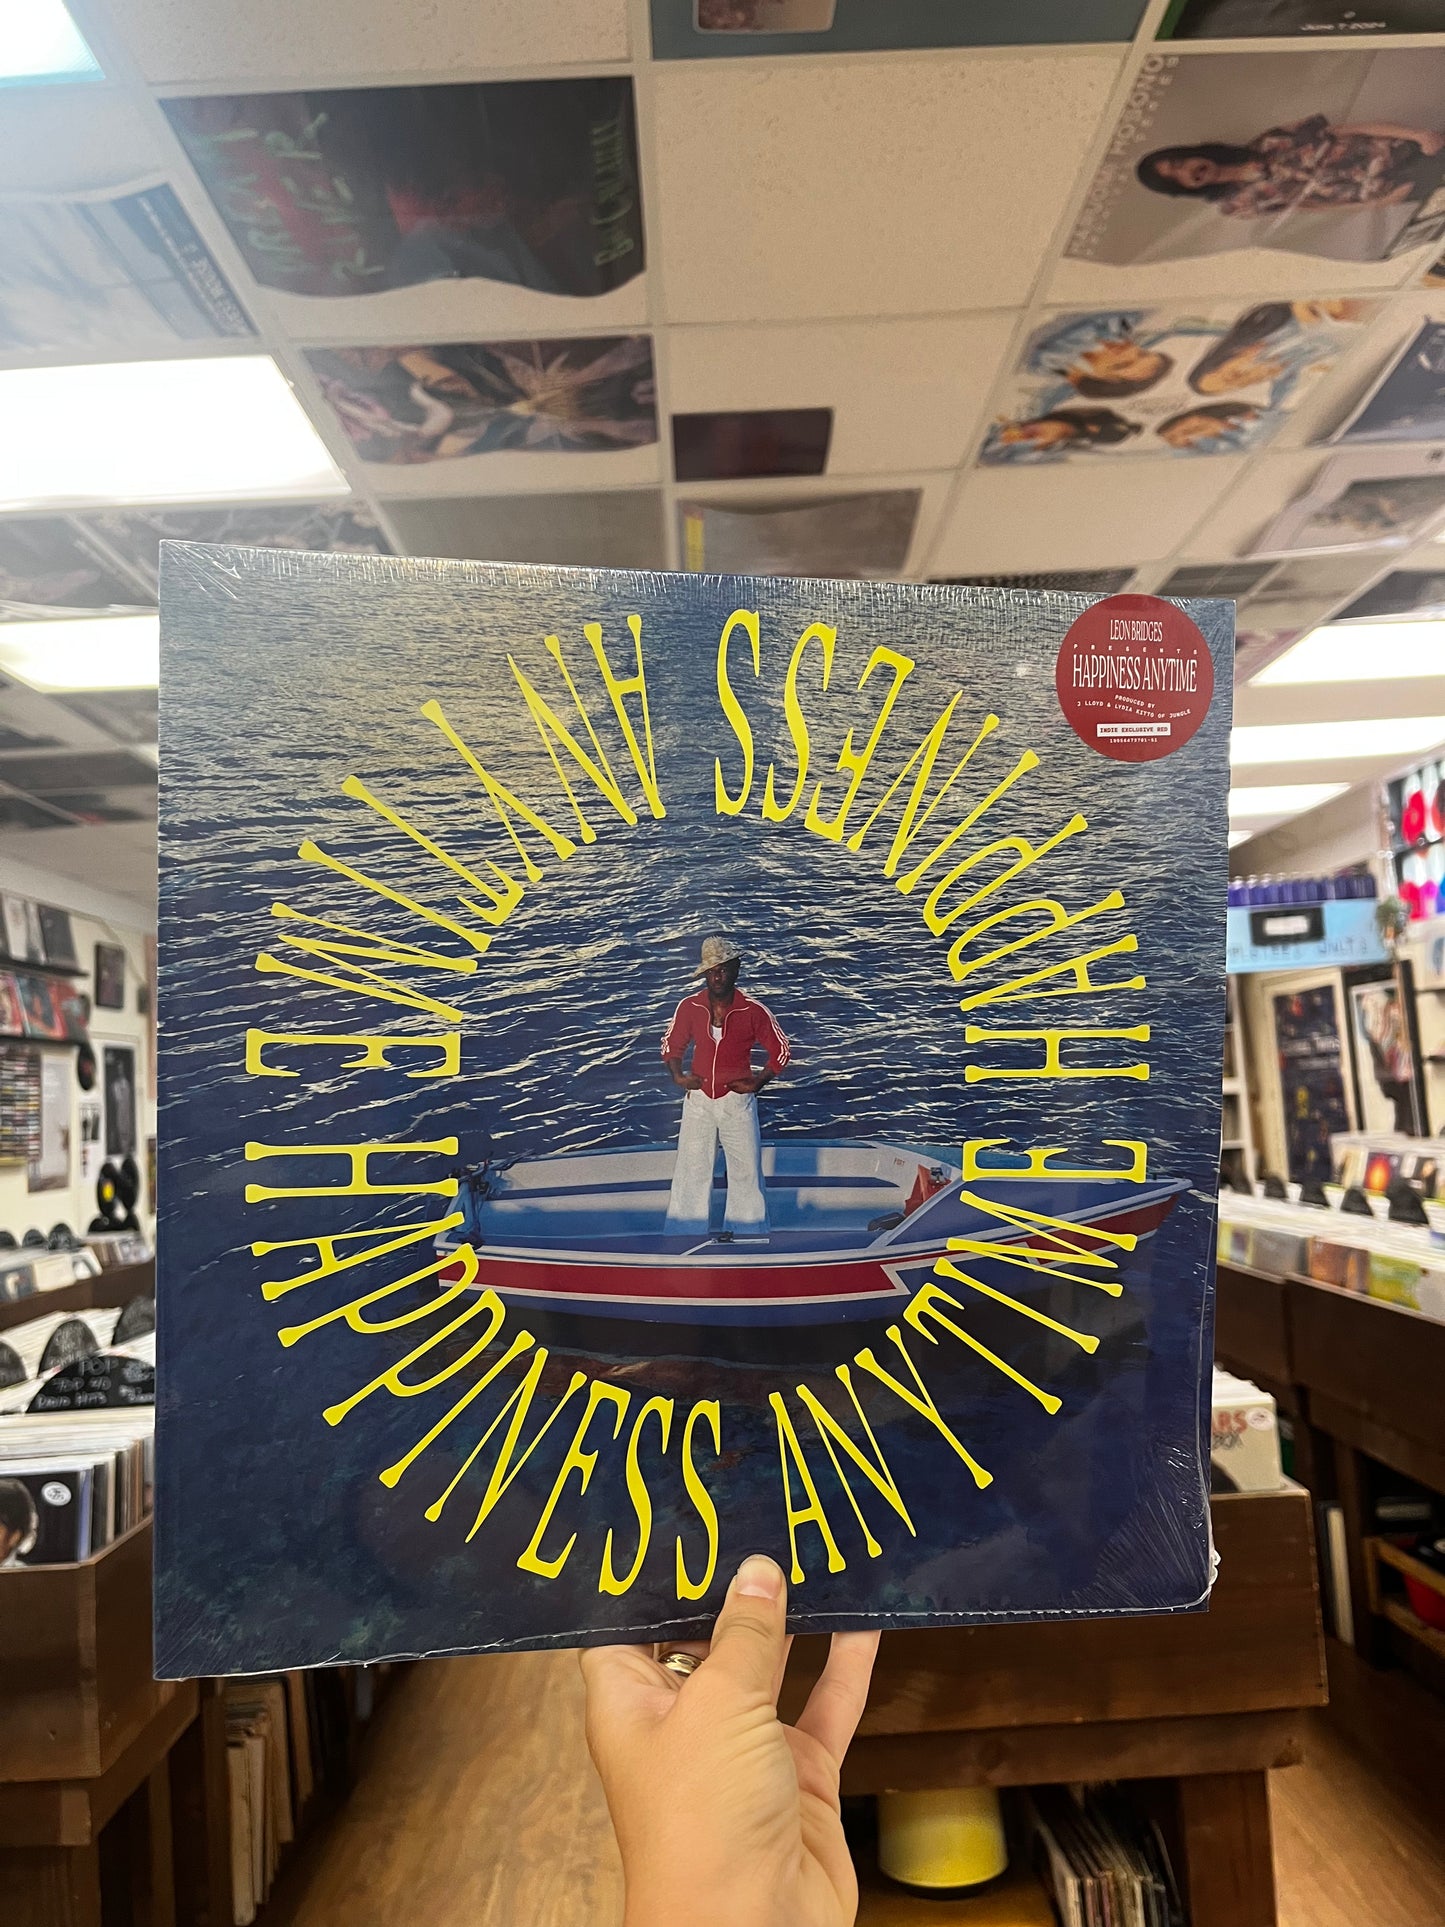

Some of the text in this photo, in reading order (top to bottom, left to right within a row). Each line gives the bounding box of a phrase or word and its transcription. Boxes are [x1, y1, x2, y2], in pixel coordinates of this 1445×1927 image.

[1110, 619, 1163, 642] LEON BRIDGES
[1073, 643, 1198, 655] PRESENTS
[1072, 654, 1198, 692] HAPPINESS ANYTIME
[1114, 694, 1145, 707] PRODUCED
[1114, 703, 1133, 713] LYDIA
[1135, 708, 1155, 718] KITTO
[1169, 708, 1192, 719] JUNGLE
[246, 610, 1151, 1082] HAPPINESS ANYTIME
[245, 1137, 1149, 1600] HAPPINESS ANYTIME
